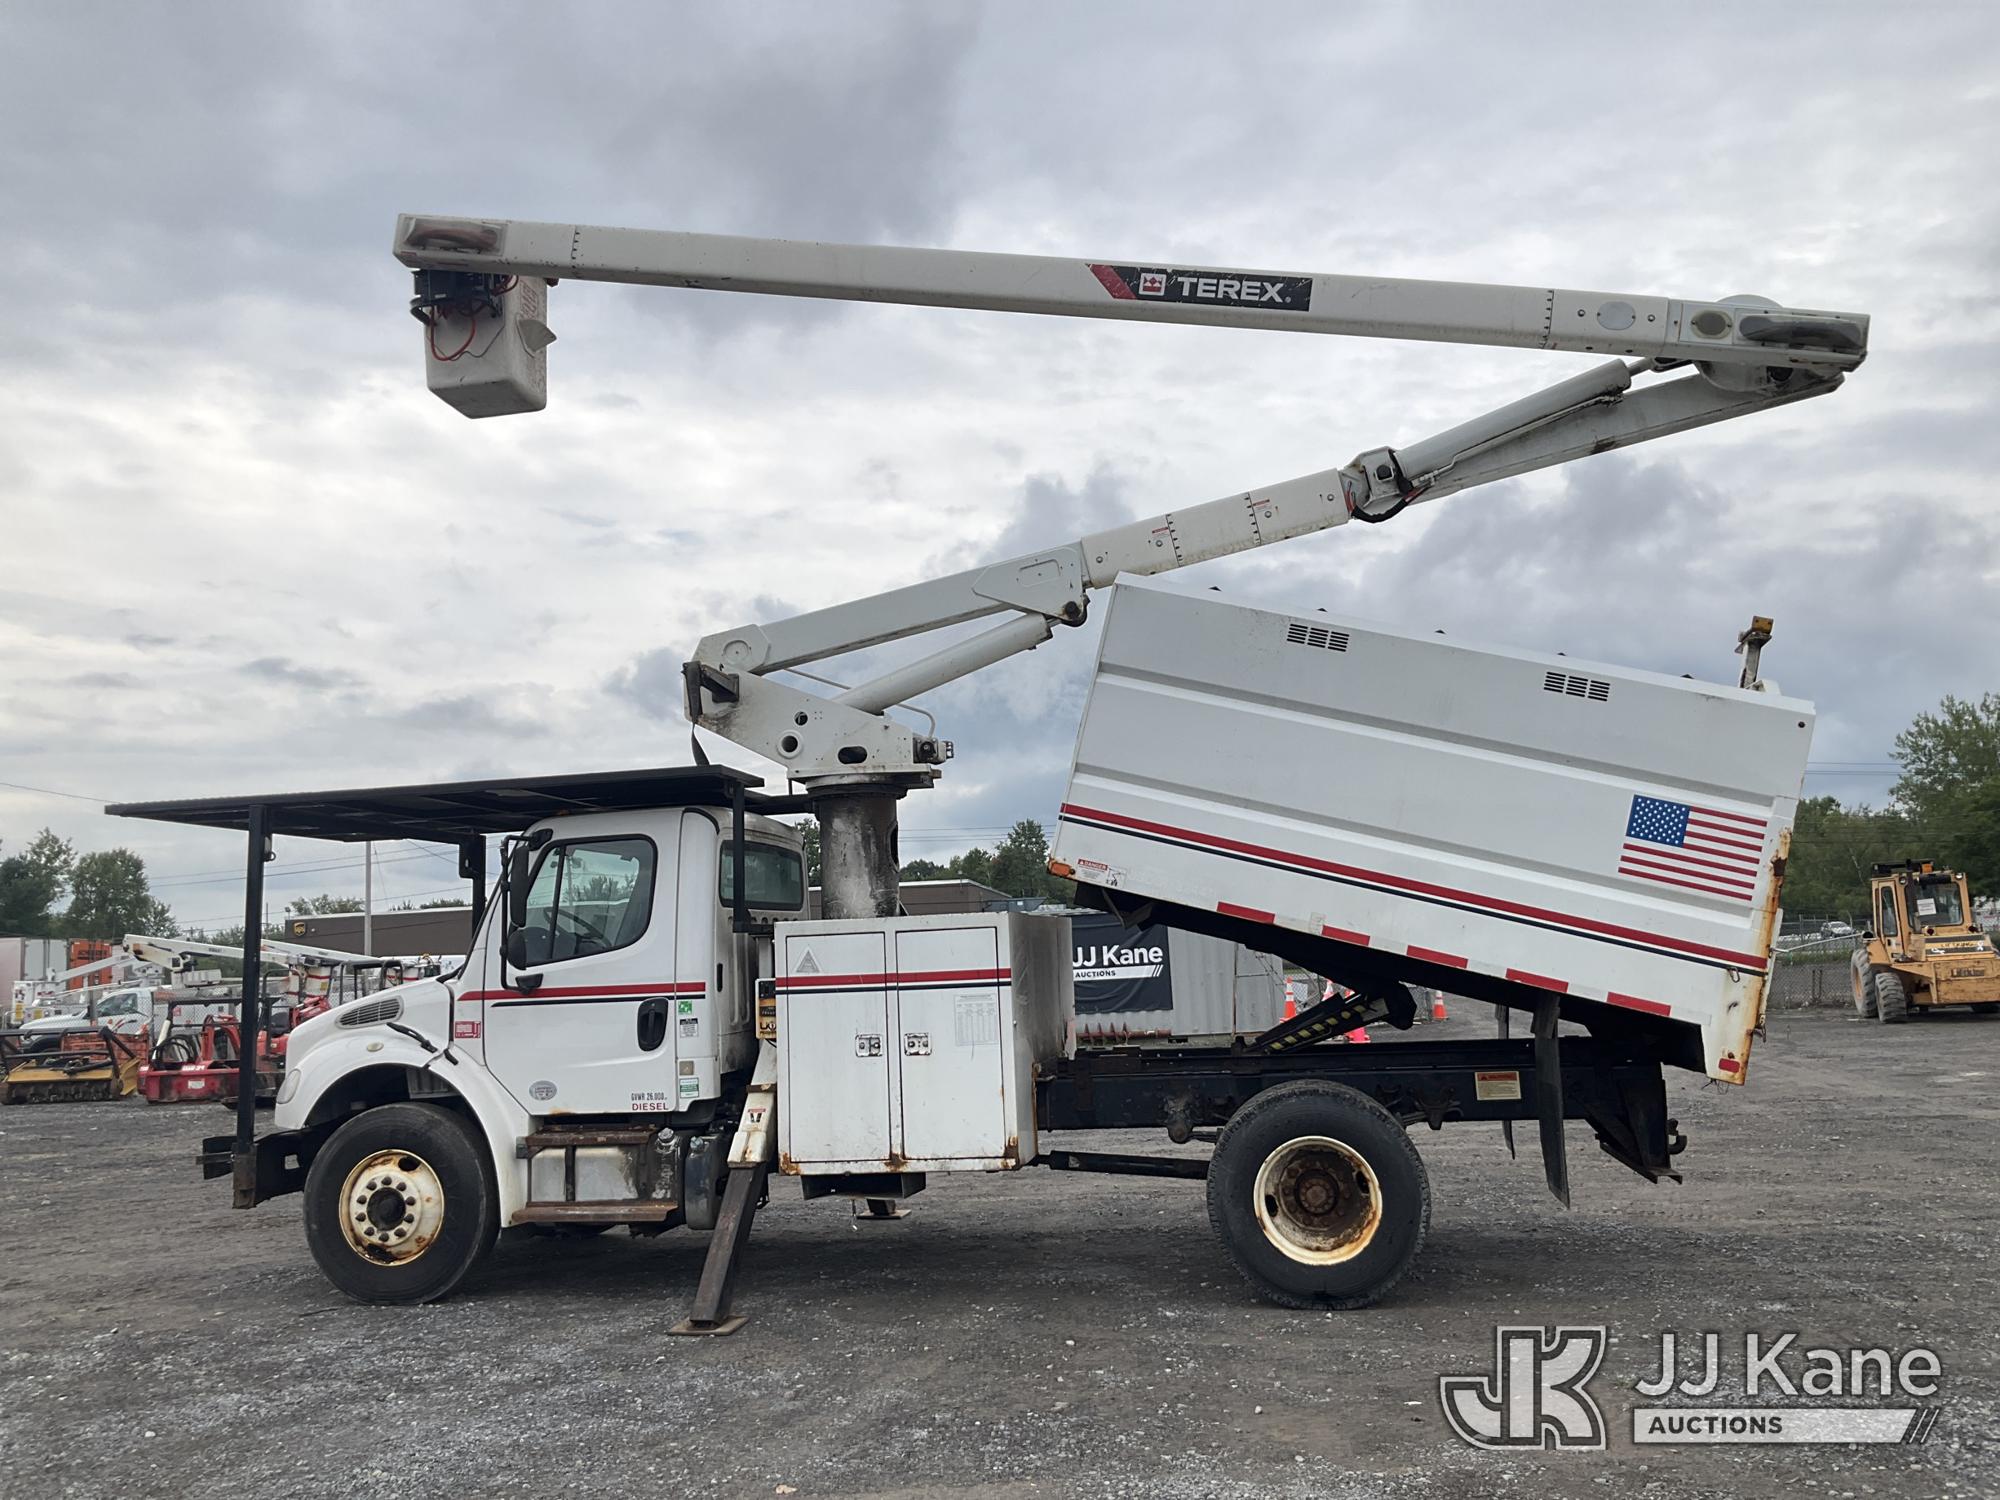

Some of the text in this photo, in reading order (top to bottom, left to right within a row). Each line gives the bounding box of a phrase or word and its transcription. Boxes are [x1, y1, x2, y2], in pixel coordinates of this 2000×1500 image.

[1177, 276, 1285, 303] TEREX
[1085, 861, 1107, 870] DANGER
[1072, 945, 1164, 967] JJ Kane
[1075, 970, 1117, 978] AUCTIONS
[631, 1092, 645, 1101] GVWR
[632, 1102, 669, 1111] DIESEL
